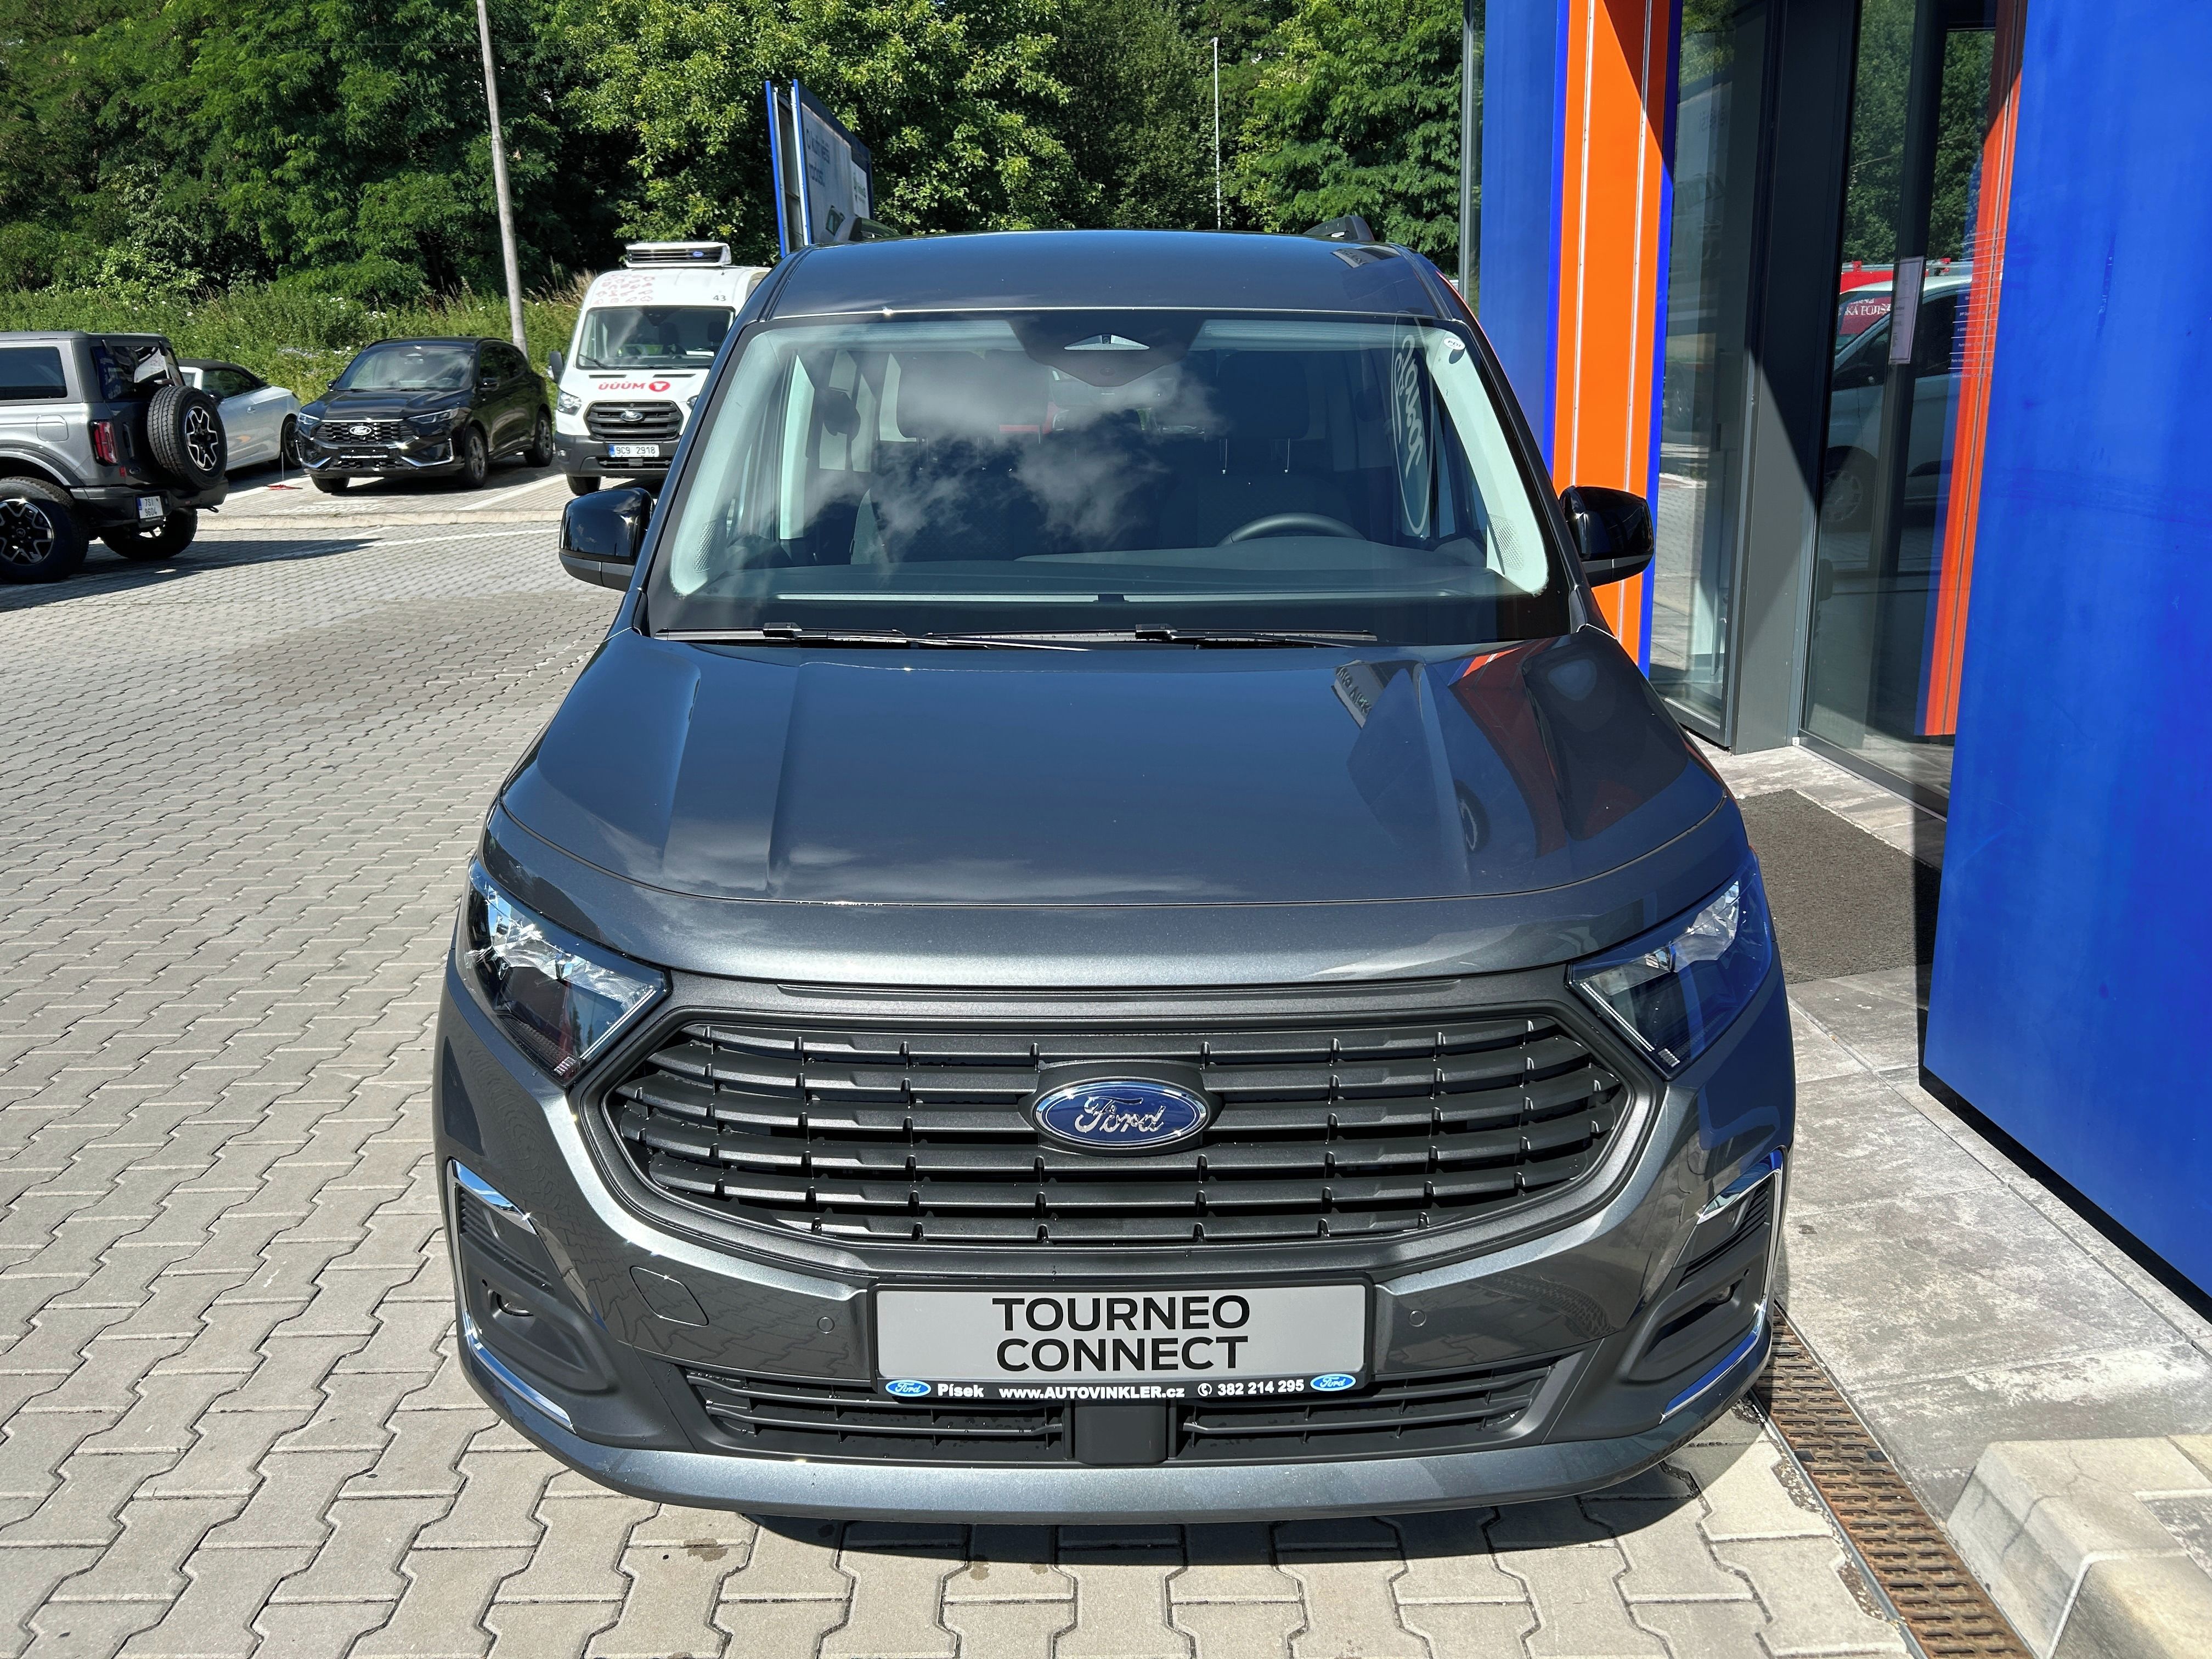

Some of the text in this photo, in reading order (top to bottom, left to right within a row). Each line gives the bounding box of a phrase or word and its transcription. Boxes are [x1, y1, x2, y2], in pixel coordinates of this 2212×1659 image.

[1074, 1095, 1167, 1133] Ford
[992, 1295, 1250, 1332] TOURNEO
[996, 1335, 1249, 1373] CONNECT
[895, 1376, 1347, 1399] Ford Písek www.AUTOVINKLER.cz 382 214 295 Ford
